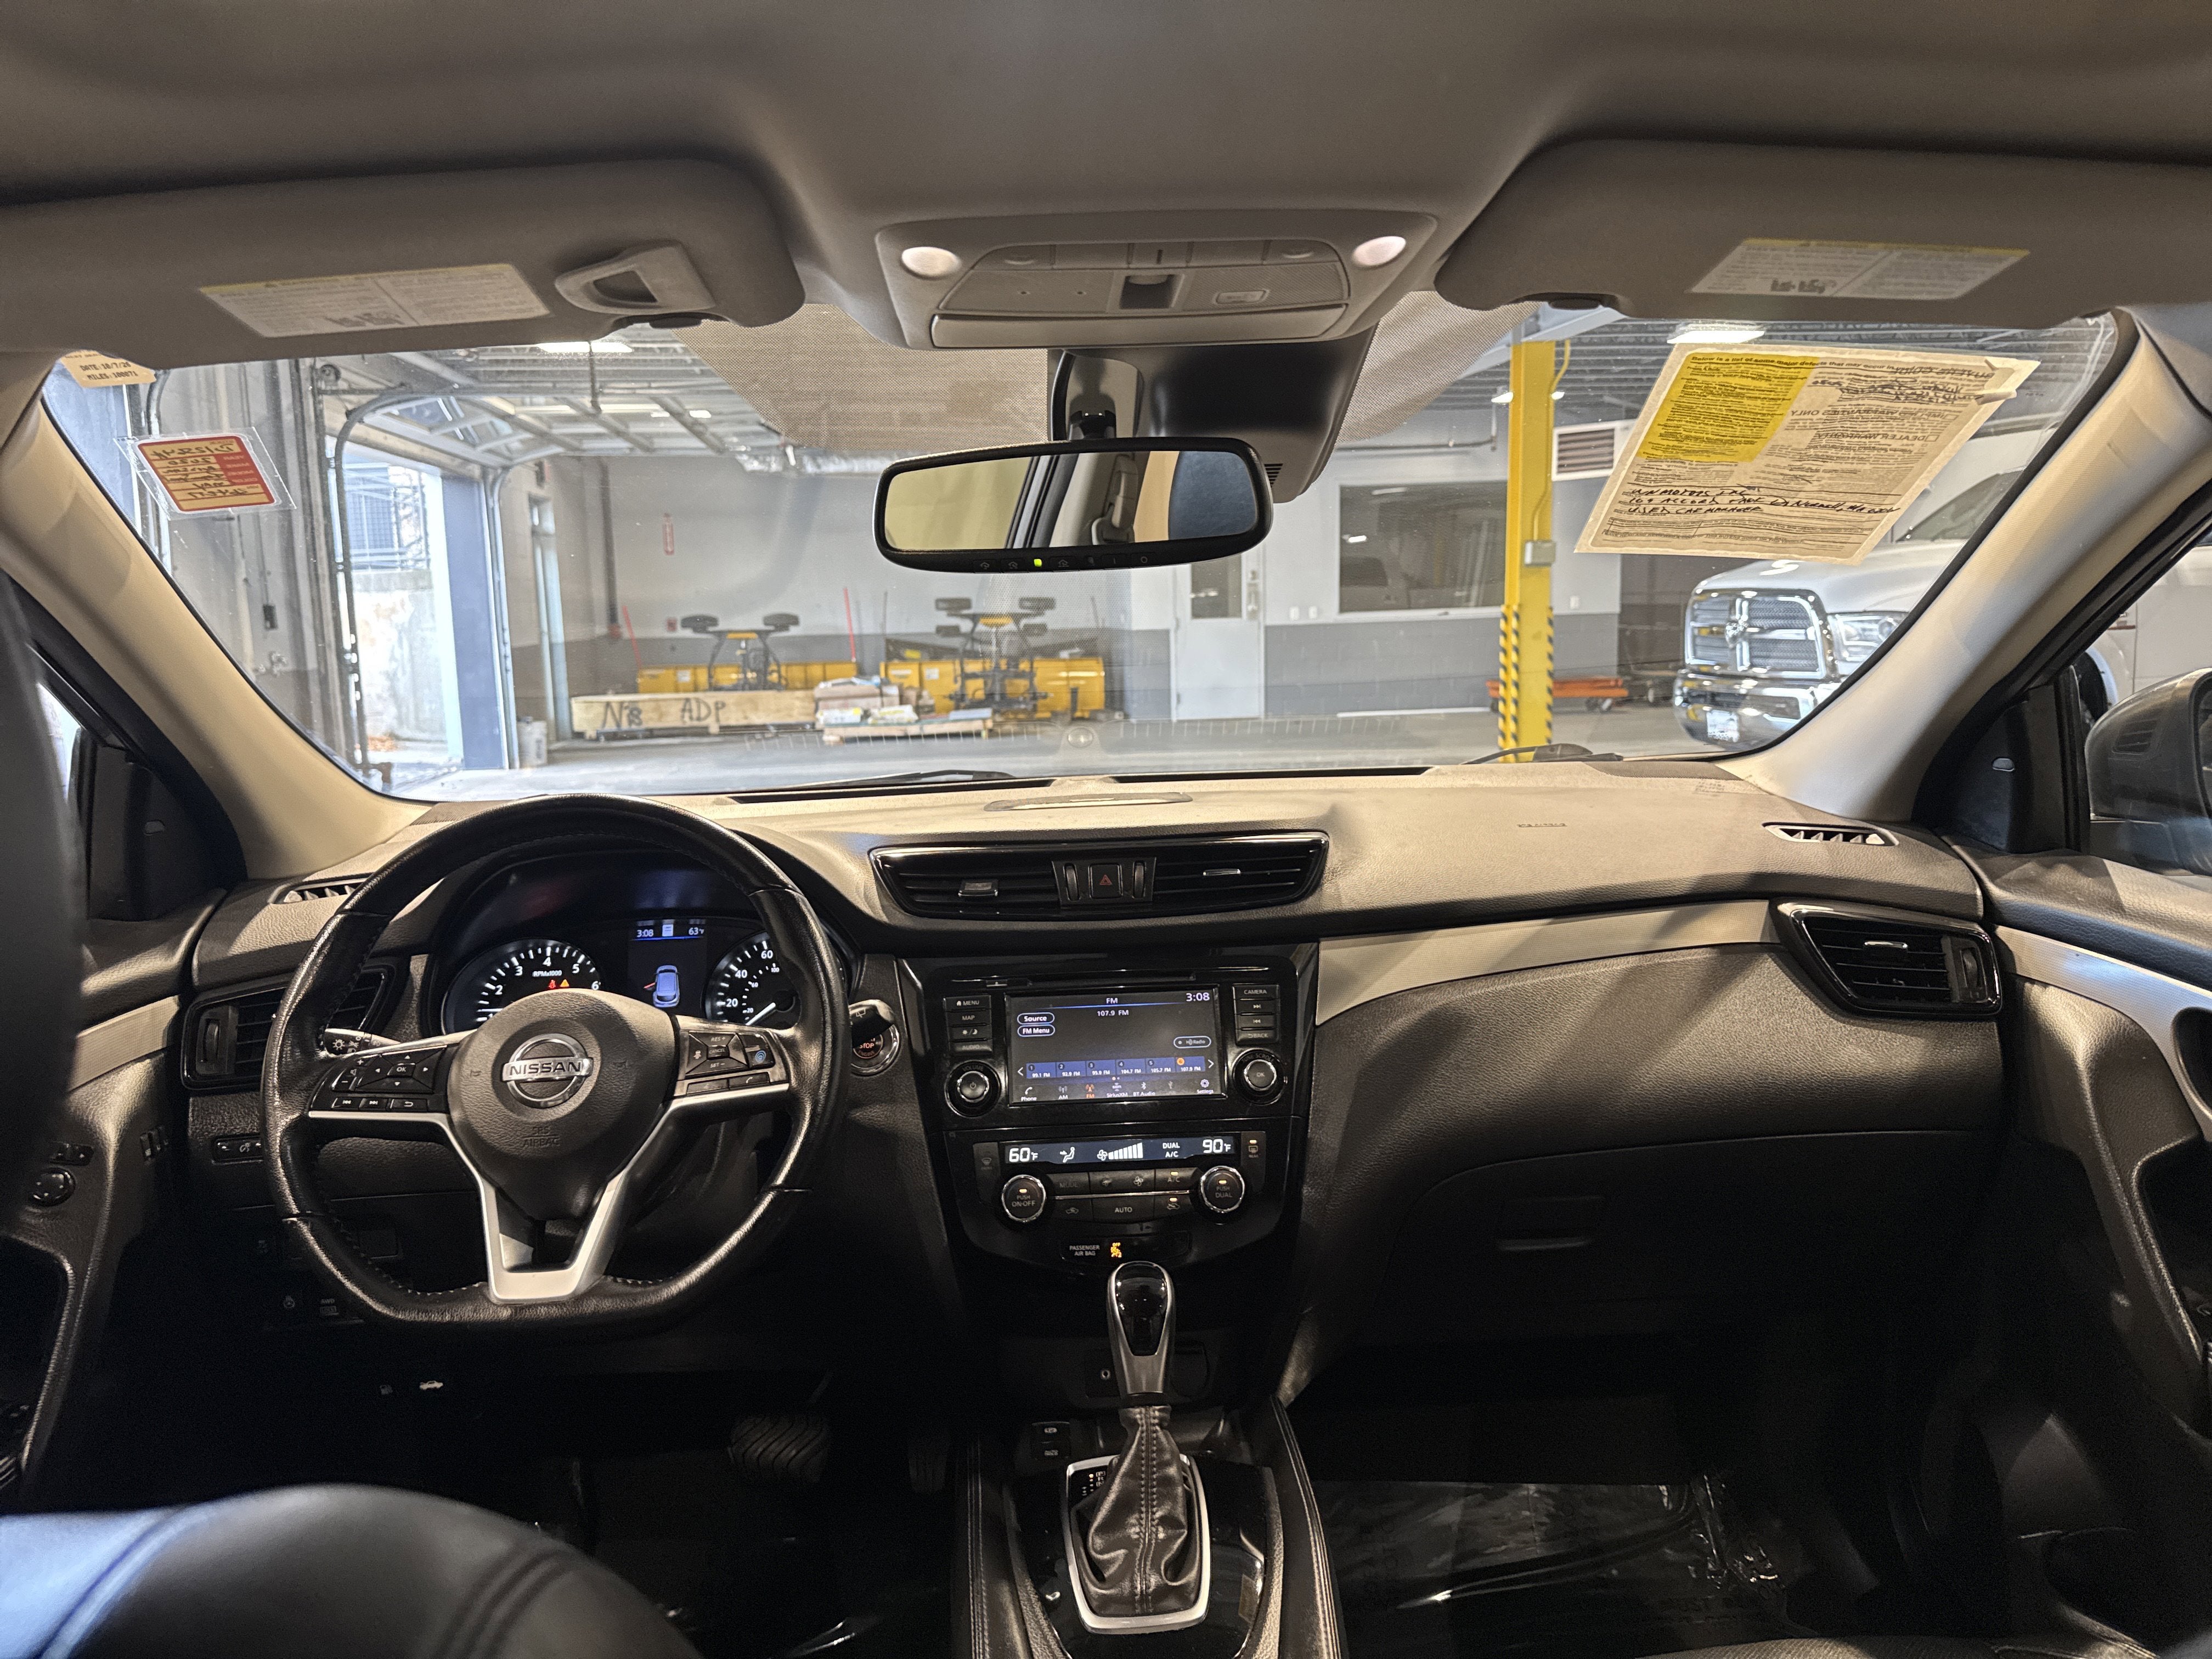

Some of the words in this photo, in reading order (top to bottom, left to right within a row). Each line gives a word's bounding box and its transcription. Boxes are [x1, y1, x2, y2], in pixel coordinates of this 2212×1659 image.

[636, 929, 654, 938] 3:08
[761, 950, 774, 959] 60
[543, 957, 551, 967] 4
[515, 966, 523, 976] 3
[572, 963, 580, 974] 5
[735, 969, 748, 978] 40
[495, 985, 503, 995] 2
[591, 980, 599, 990] 6
[1186, 992, 1210, 1002] 3:08
[726, 998, 738, 1007] 20
[510, 1062, 582, 1076] NISSAN
